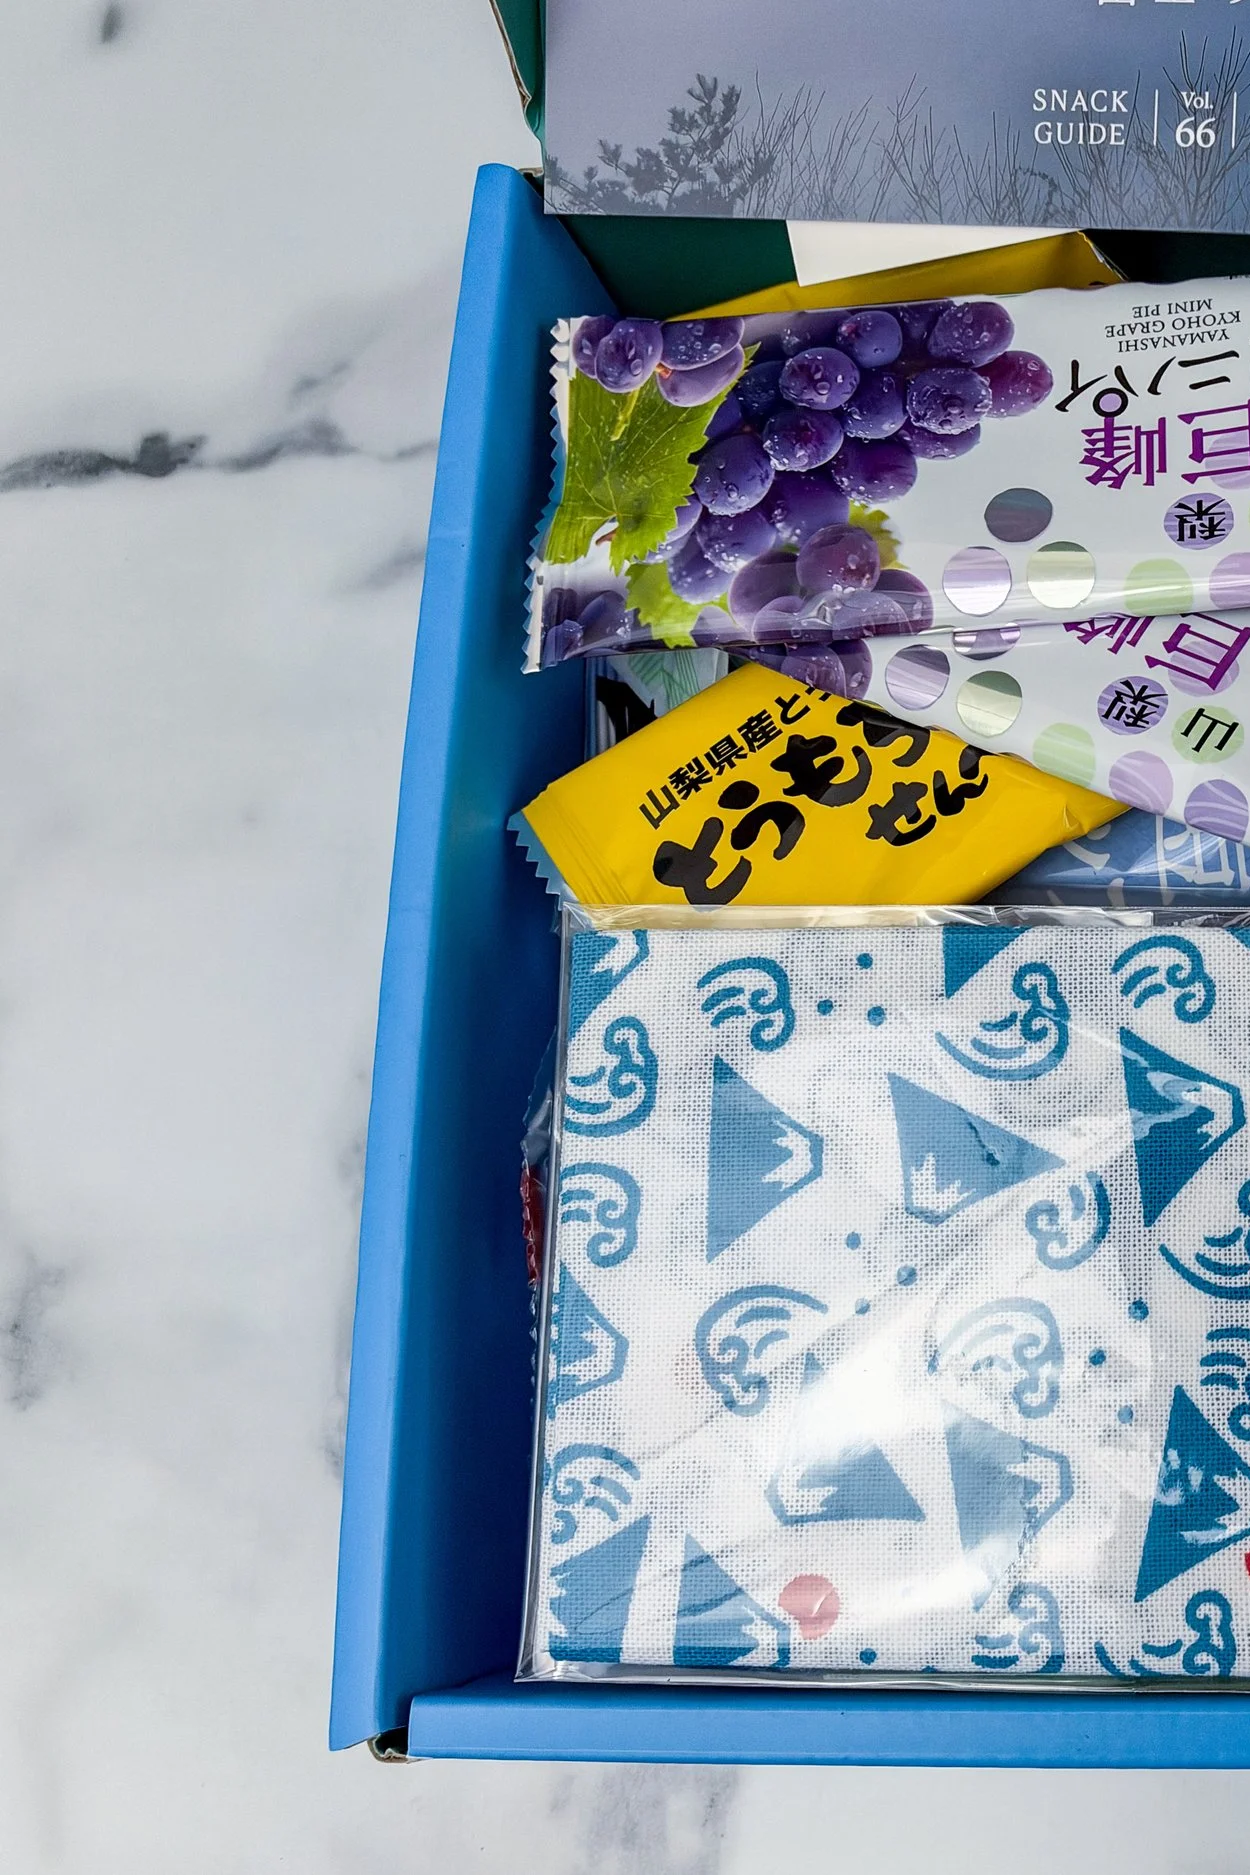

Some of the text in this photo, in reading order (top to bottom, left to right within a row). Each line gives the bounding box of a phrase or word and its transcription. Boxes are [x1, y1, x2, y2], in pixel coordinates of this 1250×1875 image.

[1032, 88, 1129, 113] SNACK
[1181, 91, 1214, 110] Vol.
[1033, 121, 1126, 146] GUIDE
[1175, 117, 1217, 149] 66
[1131, 297, 1213, 319] MINI PIE
[1104, 310, 1242, 338] KYOHO GRAPE
[1117, 327, 1231, 353] YAMANASHI
[1100, 679, 1239, 757] 山梨
